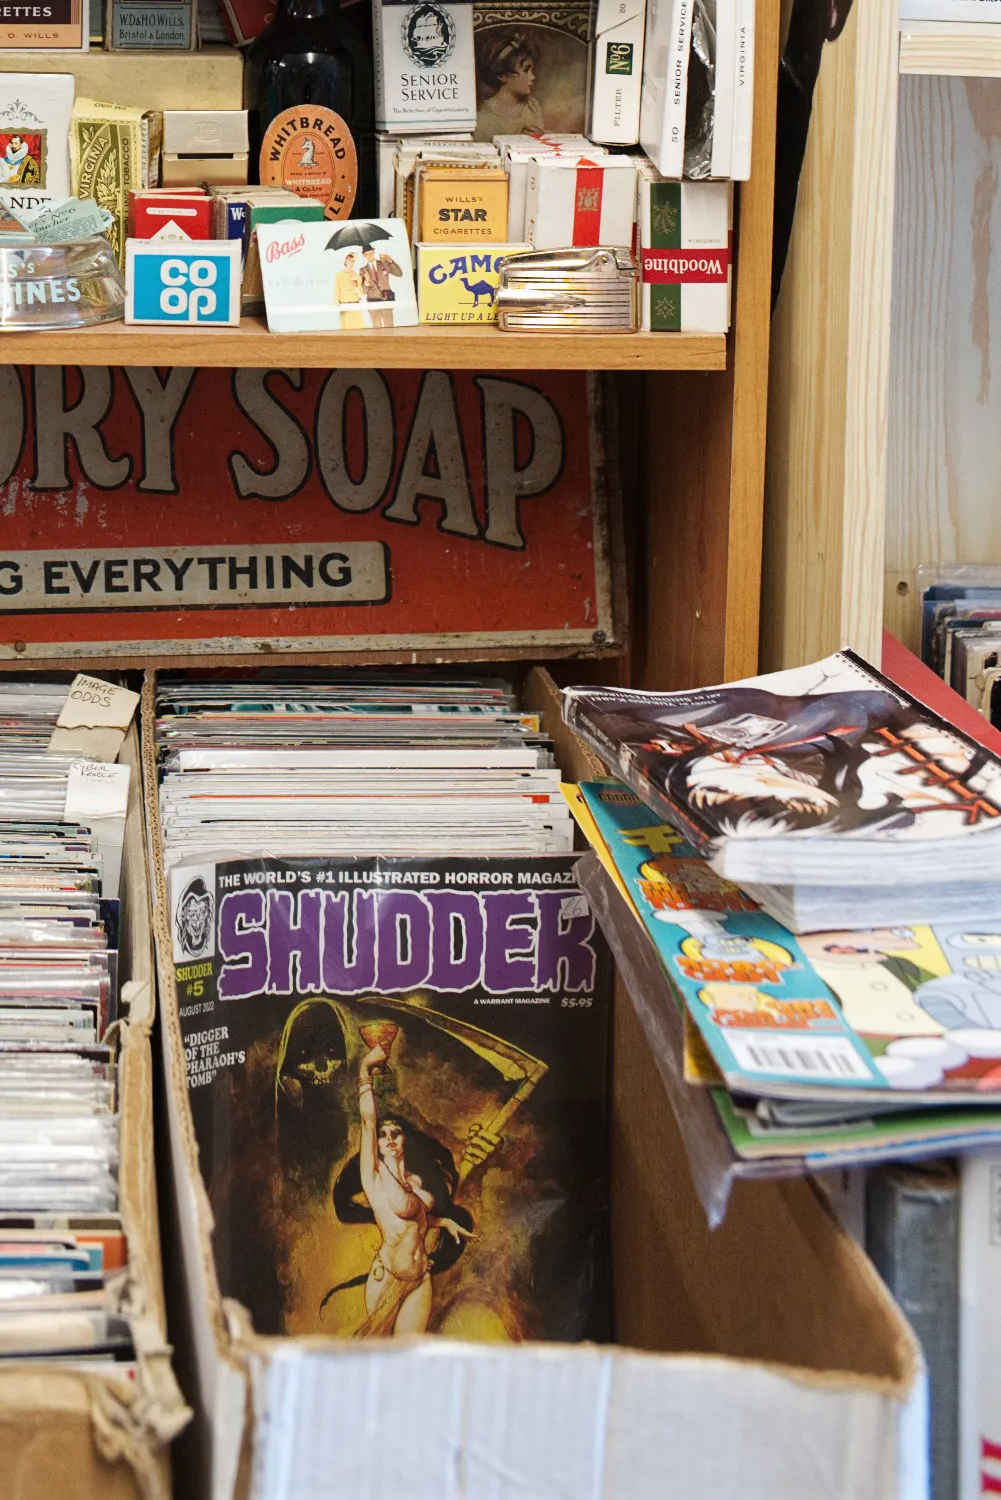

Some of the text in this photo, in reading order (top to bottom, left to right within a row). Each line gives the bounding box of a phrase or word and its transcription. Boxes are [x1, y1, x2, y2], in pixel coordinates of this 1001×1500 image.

[673, 0, 688, 105] SENIOR SERVICE
[738, 25, 747, 87] VIRGINIA
[401, 73, 457, 87] SENIOR
[401, 87, 460, 102] SERVICE
[439, 208, 487, 222] STAR
[265, 234, 306, 264] Bass
[644, 257, 723, 275] Woodbine
[228, 366, 566, 551] SOAP
[43, 552, 353, 595] EVERYTHING
[76, 676, 118, 696] IMAGE
[71, 690, 112, 708] ODDS
[218, 871, 513, 888] THE WORLD'S #1 ILLUSTRATED HORROR
[217, 889, 597, 1000] SHUDDER
